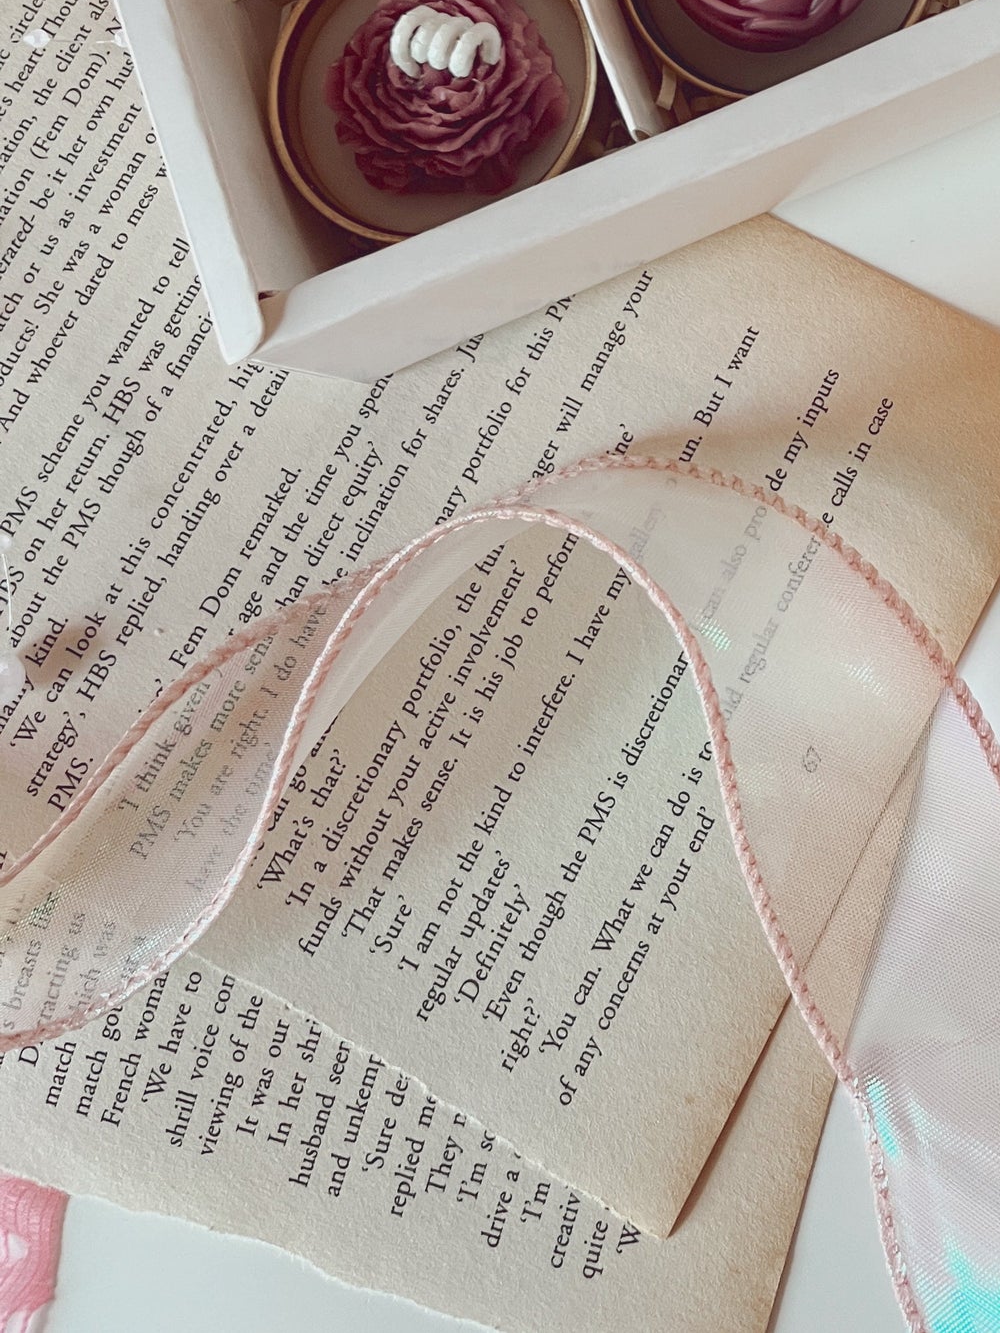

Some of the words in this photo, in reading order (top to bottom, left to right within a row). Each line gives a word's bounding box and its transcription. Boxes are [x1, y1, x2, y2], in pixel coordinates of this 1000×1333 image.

[29, 114, 70, 160] (Fem
[61, 50, 111, 108] Dom).
[29, 187, 55, 210] be
[46, 167, 68, 185] it
[57, 134, 88, 167] her
[85, 94, 115, 132] own
[32, 78, 58, 107] the
[23, 261, 42, 285] or
[39, 234, 60, 256] us
[58, 209, 76, 230] as
[68, 102, 143, 204] investment
[33, 280, 65, 315] She
[61, 240, 91, 272] was
[97, 151, 147, 215] woman
[0, 388, 31, 434] And
[26, 310, 80, 384] whoever
[74, 252, 115, 306] dared
[110, 232, 129, 251] to
[126, 184, 159, 228] mess
[0, 485, 39, 538] PMS
[37, 413, 85, 484] scheme
[81, 373, 112, 413] you
[106, 297, 156, 365] wanted
[152, 275, 171, 295] to
[24, 537, 46, 563] on
[36, 497, 68, 532] her
[65, 434, 111, 495] return.
[101, 376, 141, 426] HBS
[137, 339, 166, 372] was
[339, 464, 410, 563] inclination
[400, 427, 428, 459] for
[422, 368, 465, 425] shares.
[461, 401, 513, 486] portfolio
[504, 366, 532, 397] for
[525, 327, 554, 361] this
[41, 554, 69, 586] the
[60, 497, 101, 550] PMS
[97, 429, 147, 495] though
[144, 394, 163, 422] of
[238, 590, 263, 624] age
[260, 545, 289, 586] and
[282, 512, 310, 543] the
[305, 464, 338, 507] time
[333, 423, 362, 463] you
[9, 711, 47, 748] ‘We
[46, 667, 74, 703] can
[65, 611, 107, 660] look
[105, 582, 124, 605] at
[119, 537, 151, 576] this
[150, 399, 238, 530] concentrated,
[26, 710, 87, 798] strategy’,
[75, 649, 117, 703] HBS
[115, 575, 168, 647] replied,
[156, 487, 222, 569] handing
[214, 440, 245, 483] over
[167, 625, 208, 670] Fem
[198, 567, 243, 619] Dom
[239, 467, 303, 561] remarked.
[284, 881, 316, 907] ‘In
[321, 719, 407, 852] discretionary
[401, 625, 463, 719] portfolio,
[455, 582, 482, 614] the
[555, 395, 584, 432] will
[580, 320, 627, 393] manage
[622, 266, 654, 319] your
[18, 617, 69, 669] kind.
[127, 805, 171, 861] PMS
[169, 738, 213, 803] makes
[210, 680, 246, 733] more
[303, 511, 345, 568] direct
[341, 440, 384, 507] equity’
[416, 921, 442, 955] am
[437, 877, 464, 916] not
[456, 839, 485, 873] the
[473, 784, 513, 837] kind
[507, 761, 526, 783] to
[517, 673, 576, 757] interfere.
[573, 604, 611, 651] have
[692, 390, 725, 428] But
[727, 325, 760, 371] want
[481, 969, 526, 1023] ‘Even
[518, 890, 568, 962] though
[560, 850, 588, 883] the
[576, 791, 616, 846] PMS
[607, 771, 629, 791] is
[783, 430, 809, 465] my
[796, 369, 840, 428] inputs
[46, 757, 94, 813] PMS.
[298, 896, 343, 958] funds
[338, 807, 393, 888] without
[387, 754, 422, 808] your
[419, 692, 457, 750] active
[447, 559, 526, 687] involvement’
[340, 885, 386, 938] ‘That
[381, 817, 424, 882] makes
[420, 758, 459, 813] sense.
[448, 728, 473, 749] It
[462, 706, 485, 725] is
[474, 671, 504, 702] his
[494, 634, 524, 671] job
[520, 606, 539, 627] to
[538, 1012, 577, 1054] ‘You
[573, 967, 603, 1006] can.
[590, 897, 636, 951] What
[629, 863, 653, 891] we
[650, 824, 675, 859] can
[666, 790, 691, 817] do
[681, 767, 703, 786] is
[830, 466, 858, 507] calls
[847, 442, 872, 463] in
[867, 397, 894, 436] case
[256, 815, 315, 890] ‘What’s
[310, 748, 347, 809] that?’
[368, 894, 413, 954] ‘Sure’
[415, 945, 463, 1023] regular
[459, 849, 512, 939] updates’
[453, 883, 531, 1004] ‘Definitely’
[559, 1074, 578, 1107] of
[574, 1035, 603, 1077] any
[597, 940, 650, 1031] concerns
[647, 911, 665, 935] at
[659, 857, 692, 912] your
[688, 805, 716, 853] end’
[45, 1035, 77, 1108] match
[140, 1062, 173, 1103] ‘We
[157, 1003, 192, 1055] have
[184, 971, 203, 993] to
[229, 1033, 250, 1063] of
[236, 995, 264, 1031] the
[500, 997, 541, 1074] right?’
[75, 1050, 108, 1118] match
[100, 1053, 142, 1128] French
[164, 1089, 199, 1148] shrill
[190, 1024, 220, 1081] voice
[198, 1071, 245, 1156] viewing
[235, 1115, 260, 1138] It
[250, 1067, 275, 1107] was
[268, 1018, 291, 1059] our
[266, 1122, 293, 1148] In
[277, 1071, 308, 1112] her
[287, 1091, 336, 1189] husband
[327, 1152, 352, 1198] and
[361, 1117, 397, 1173] ‘Sure
[390, 1136, 426, 1218] replied
[424, 1134, 464, 1194] They
[456, 1162, 488, 1203] ‘I’m
[480, 1190, 513, 1249] drive
[519, 1182, 552, 1223] ‘I’m
[582, 1220, 609, 1280] quite
